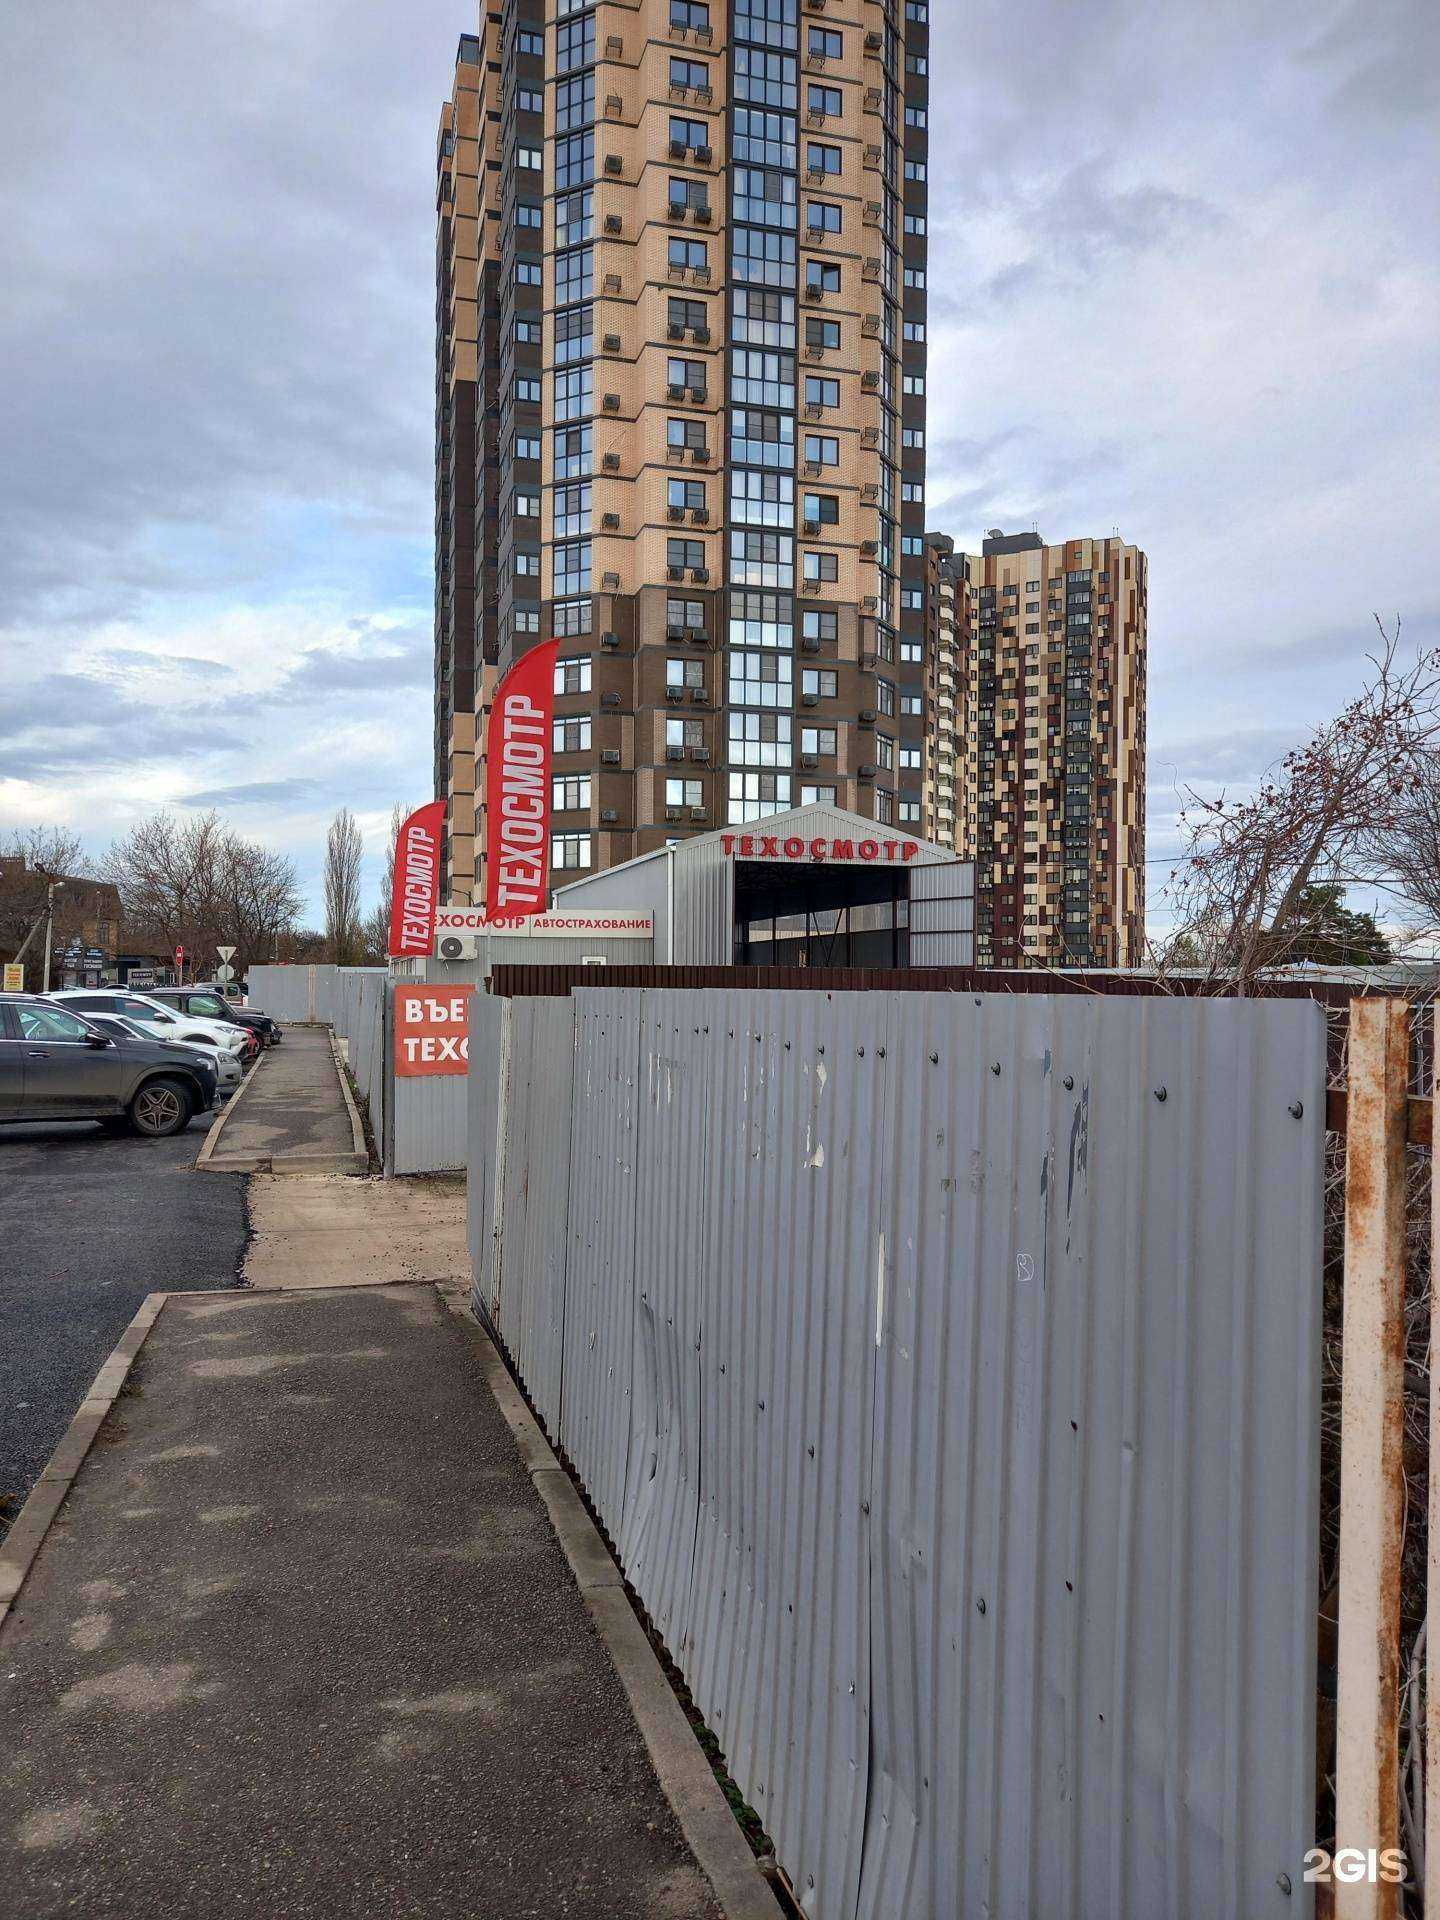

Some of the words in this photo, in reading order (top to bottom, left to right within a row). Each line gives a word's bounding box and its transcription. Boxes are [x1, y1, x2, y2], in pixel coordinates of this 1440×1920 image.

[498, 694, 545, 907] ТЕХОСМОТР
[720, 834, 919, 861] ТЕХОСМОТР
[401, 826, 435, 950] ТЕХОСМОТР
[533, 918, 651, 929] АВТОСТРАХОВАНИЕ
[405, 998, 469, 1022] ВЪЕ
